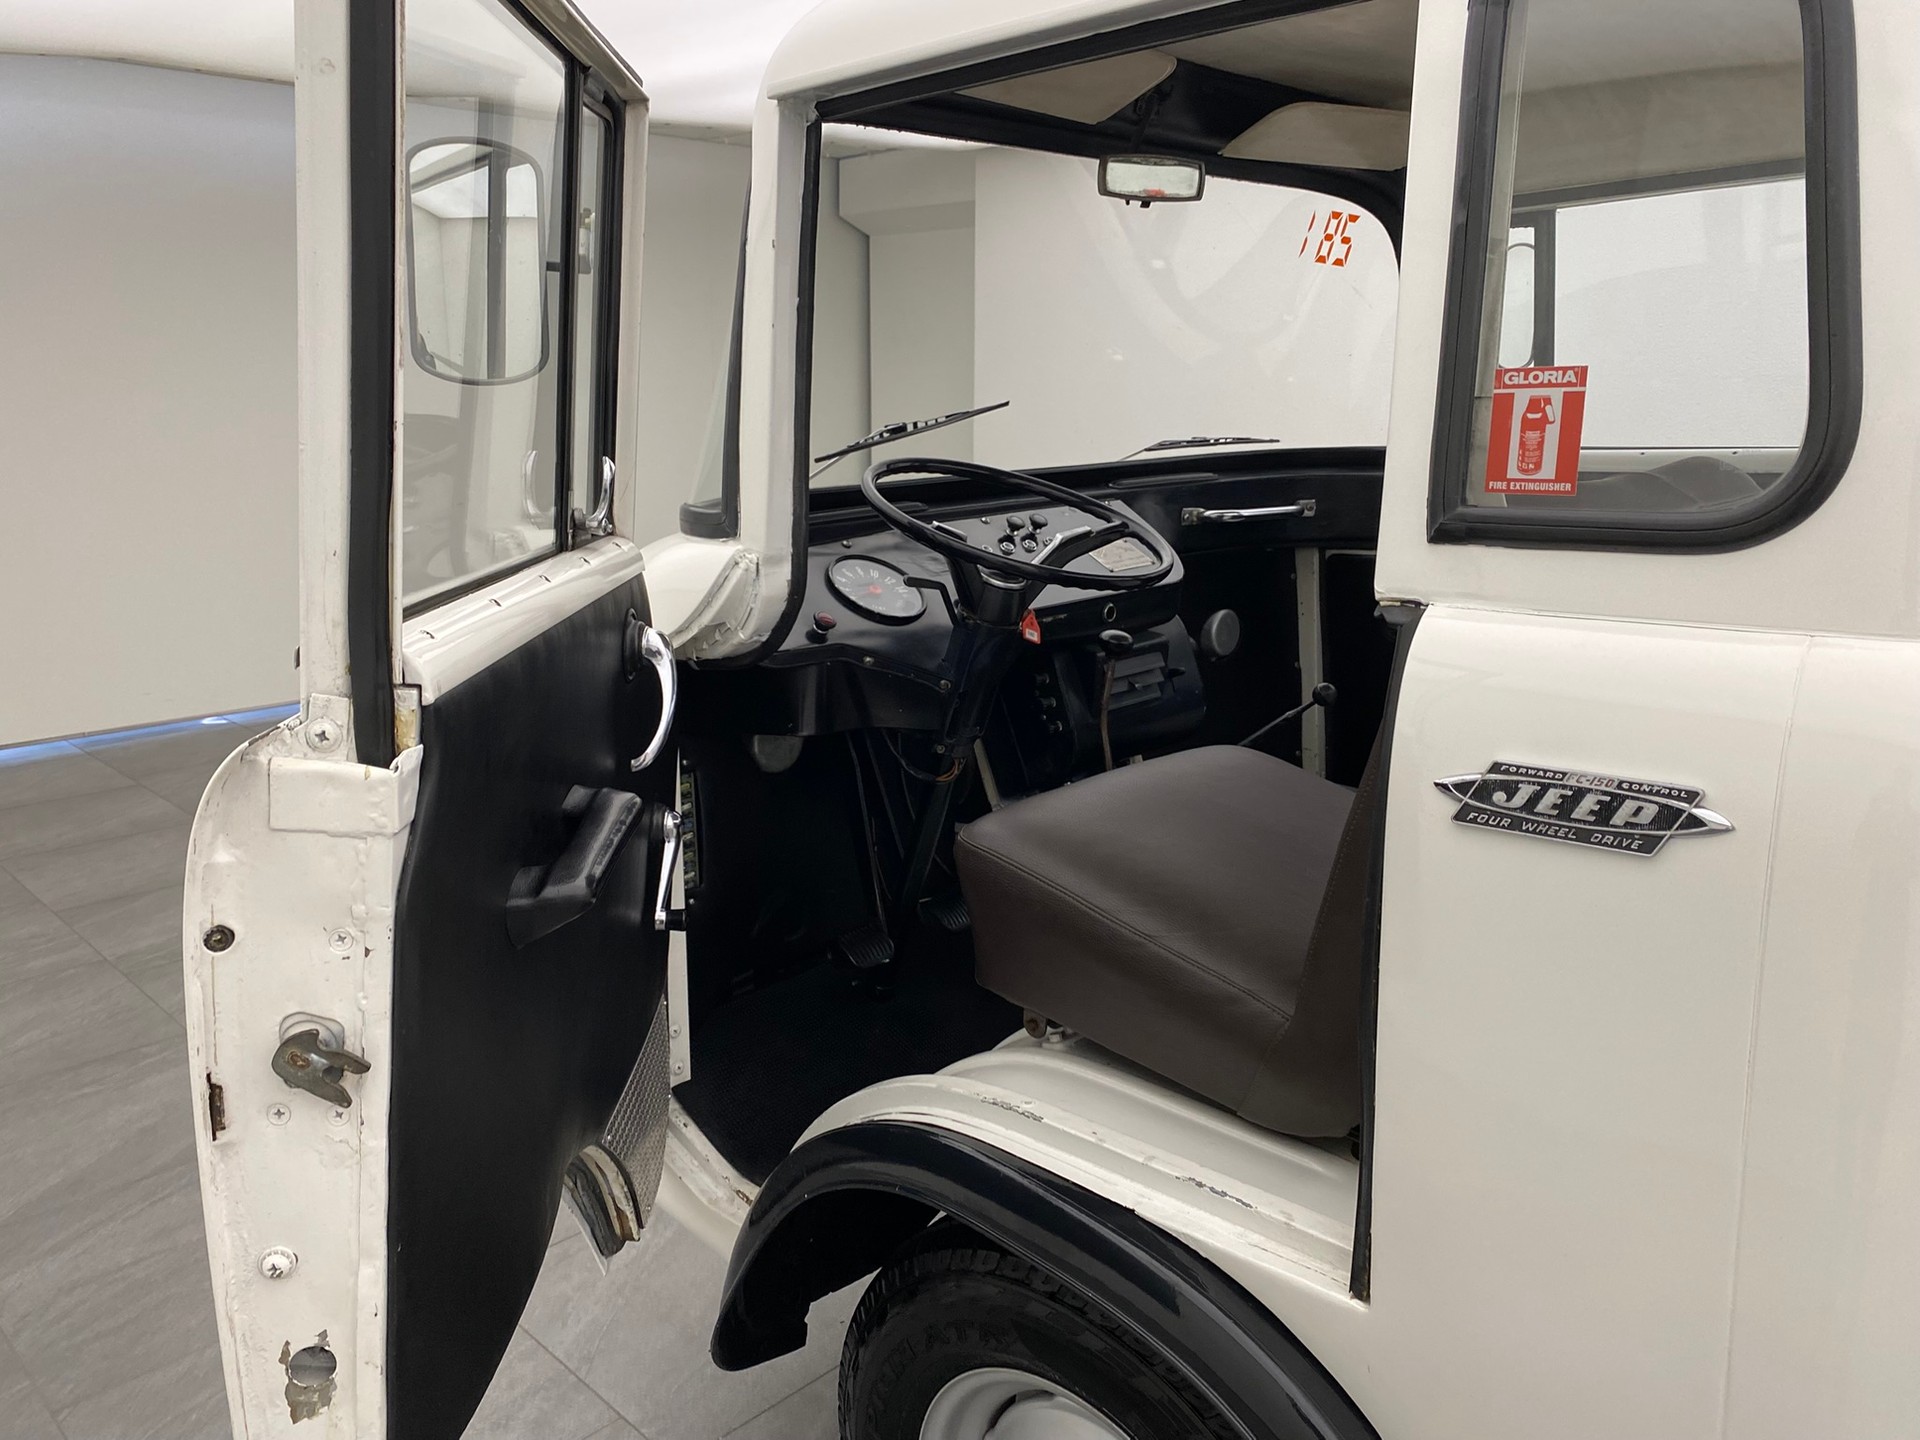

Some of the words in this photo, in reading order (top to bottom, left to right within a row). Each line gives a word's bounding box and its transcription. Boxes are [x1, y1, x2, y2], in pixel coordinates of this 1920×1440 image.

[1299, 210, 1361, 267] 185
[1503, 370, 1577, 385] GLORIA
[1488, 481, 1507, 490] FIRE
[1510, 481, 1572, 491] EXTINGUISHER
[1500, 764, 1563, 780] FORWARD
[1567, 773, 1616, 789] FC-150
[1621, 782, 1689, 798] CONTROL
[1492, 783, 1660, 827] JEEP
[1466, 812, 1513, 828] FOUR
[1521, 821, 1578, 839] WHEEL
[1590, 833, 1643, 851] DRIVE
